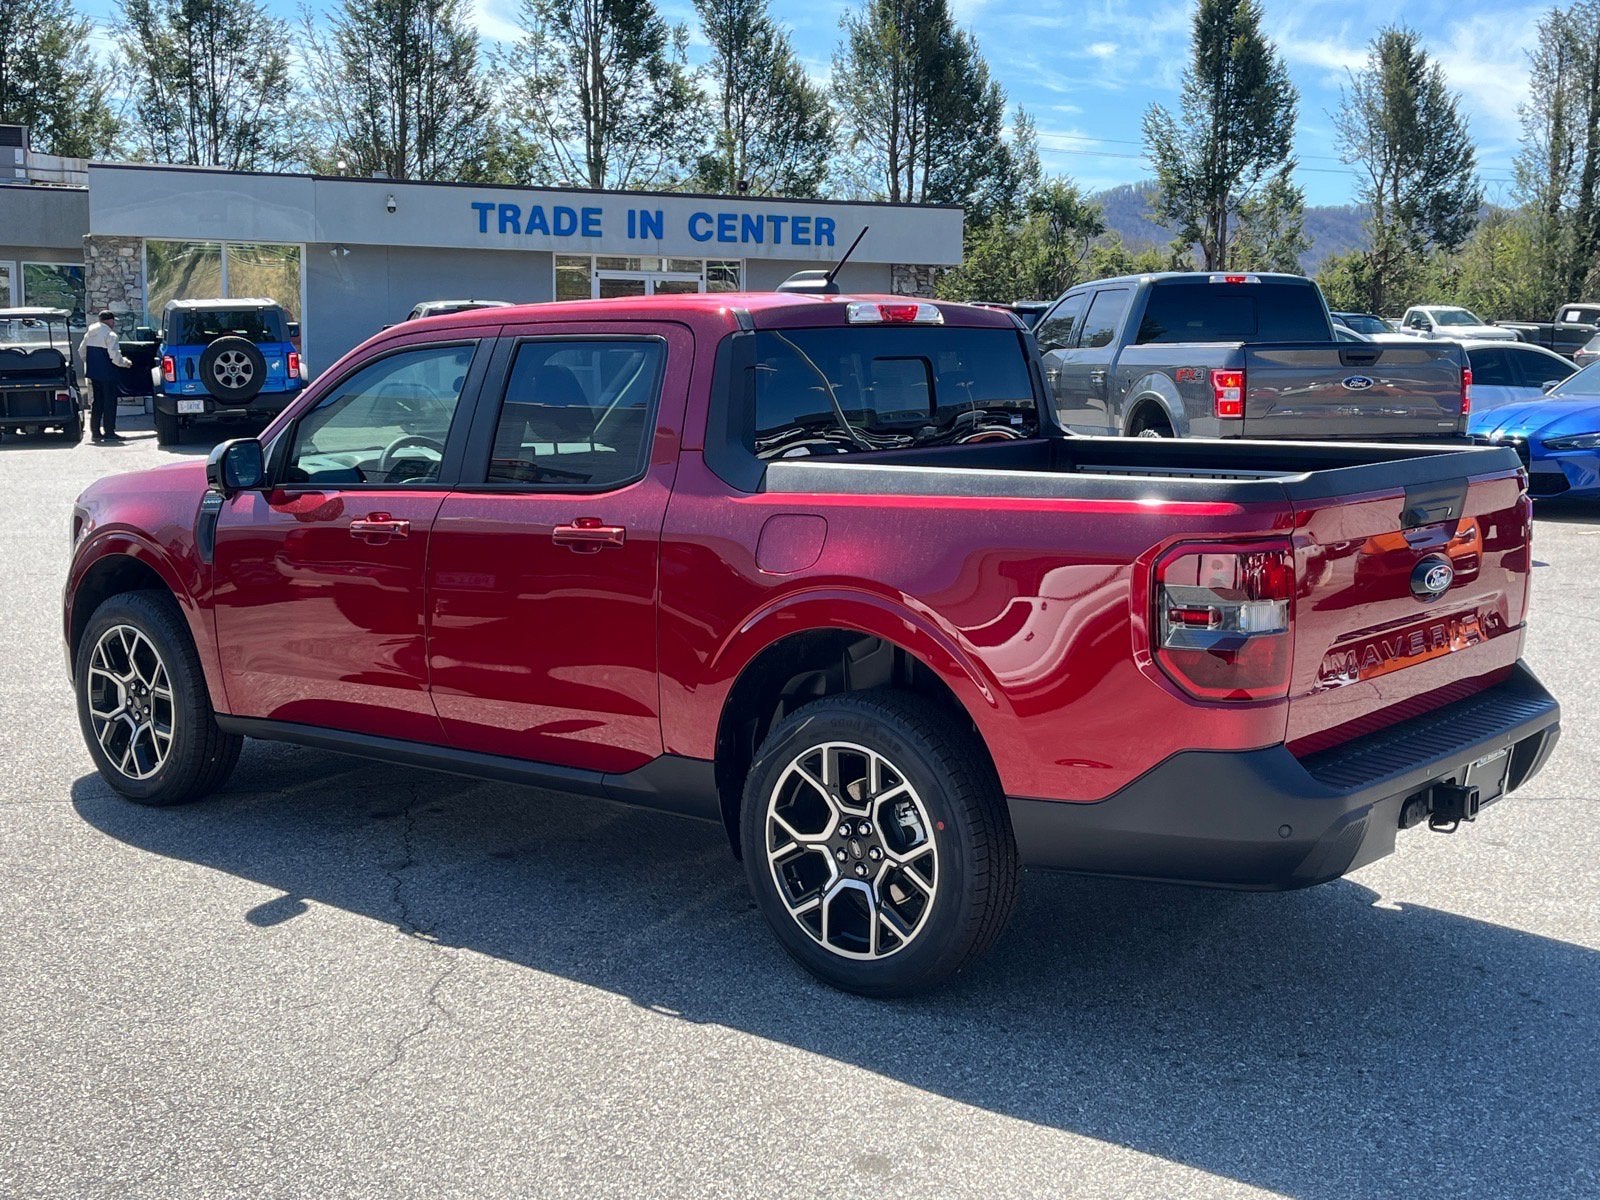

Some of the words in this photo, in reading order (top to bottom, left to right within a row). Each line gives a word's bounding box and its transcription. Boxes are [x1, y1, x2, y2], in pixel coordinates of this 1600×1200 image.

[471, 203, 603, 237] TRADE
[627, 210, 664, 239] IN
[688, 213, 836, 246] CENTER
[1175, 368, 1206, 384] FX4
[1349, 378, 1368, 388] Ford
[1429, 568, 1449, 588] Ford
[1321, 609, 1500, 676] MAVERICK
